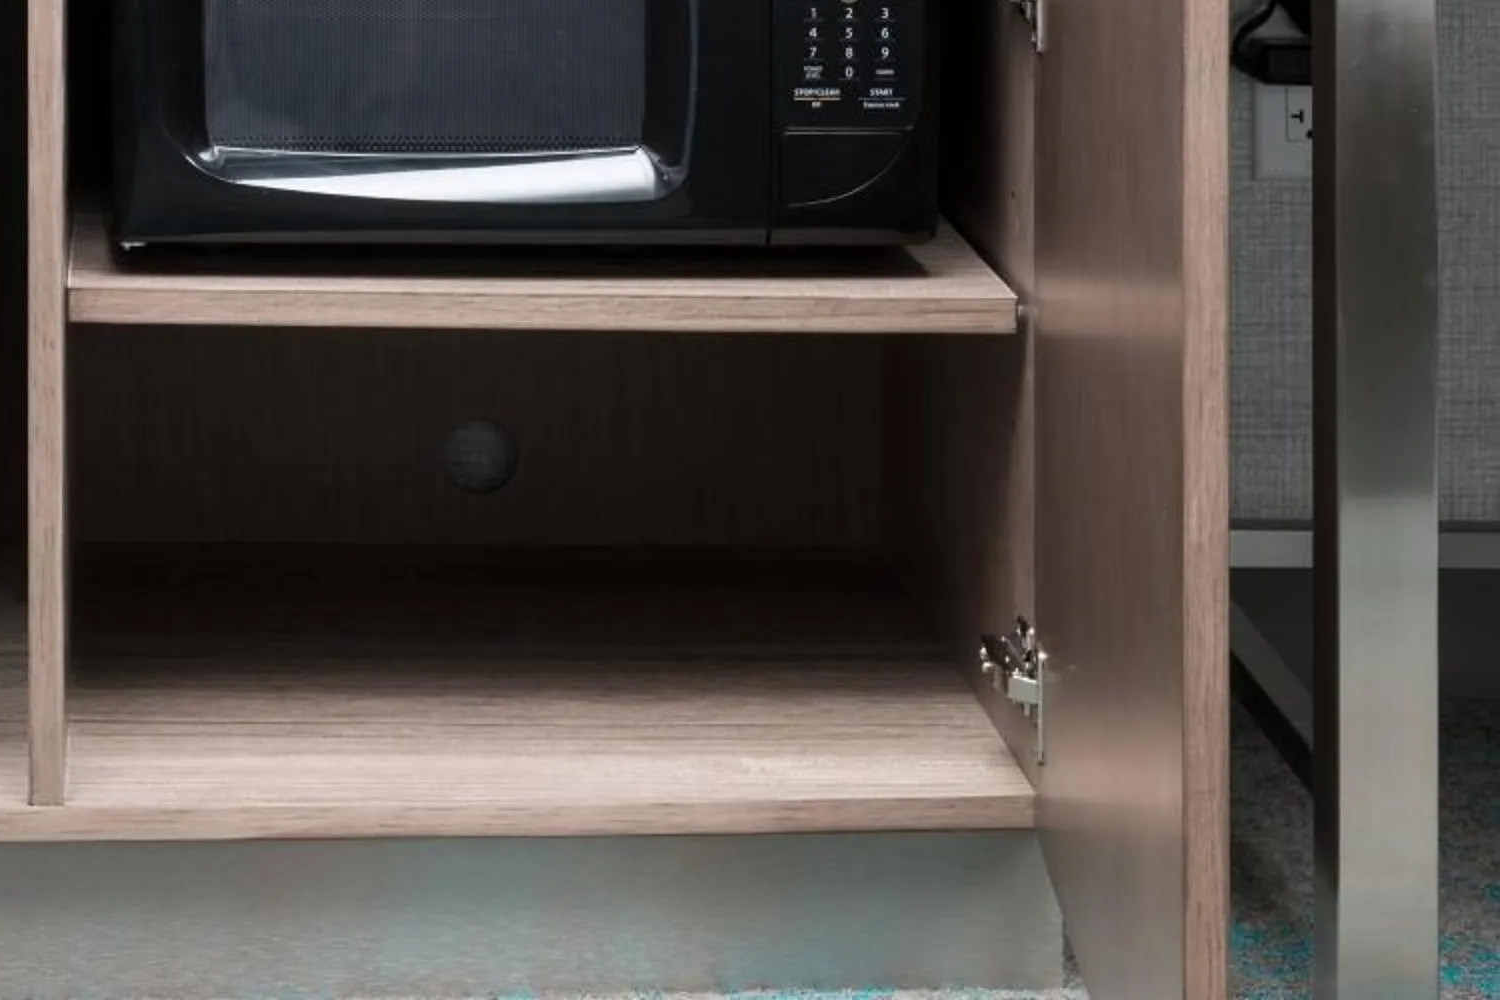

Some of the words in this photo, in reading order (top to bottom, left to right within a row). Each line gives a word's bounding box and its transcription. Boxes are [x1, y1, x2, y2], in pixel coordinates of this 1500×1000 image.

[809, 7, 817, 18] 1
[845, 7, 853, 18] 2
[881, 7, 889, 18] 3
[809, 27, 817, 38] 4
[845, 27, 853, 38] 5
[881, 27, 889, 38] 6
[809, 47, 817, 58] 7
[845, 47, 853, 58] 8
[881, 47, 889, 58] 9
[845, 67, 853, 78] 0
[869, 88, 894, 97] START
